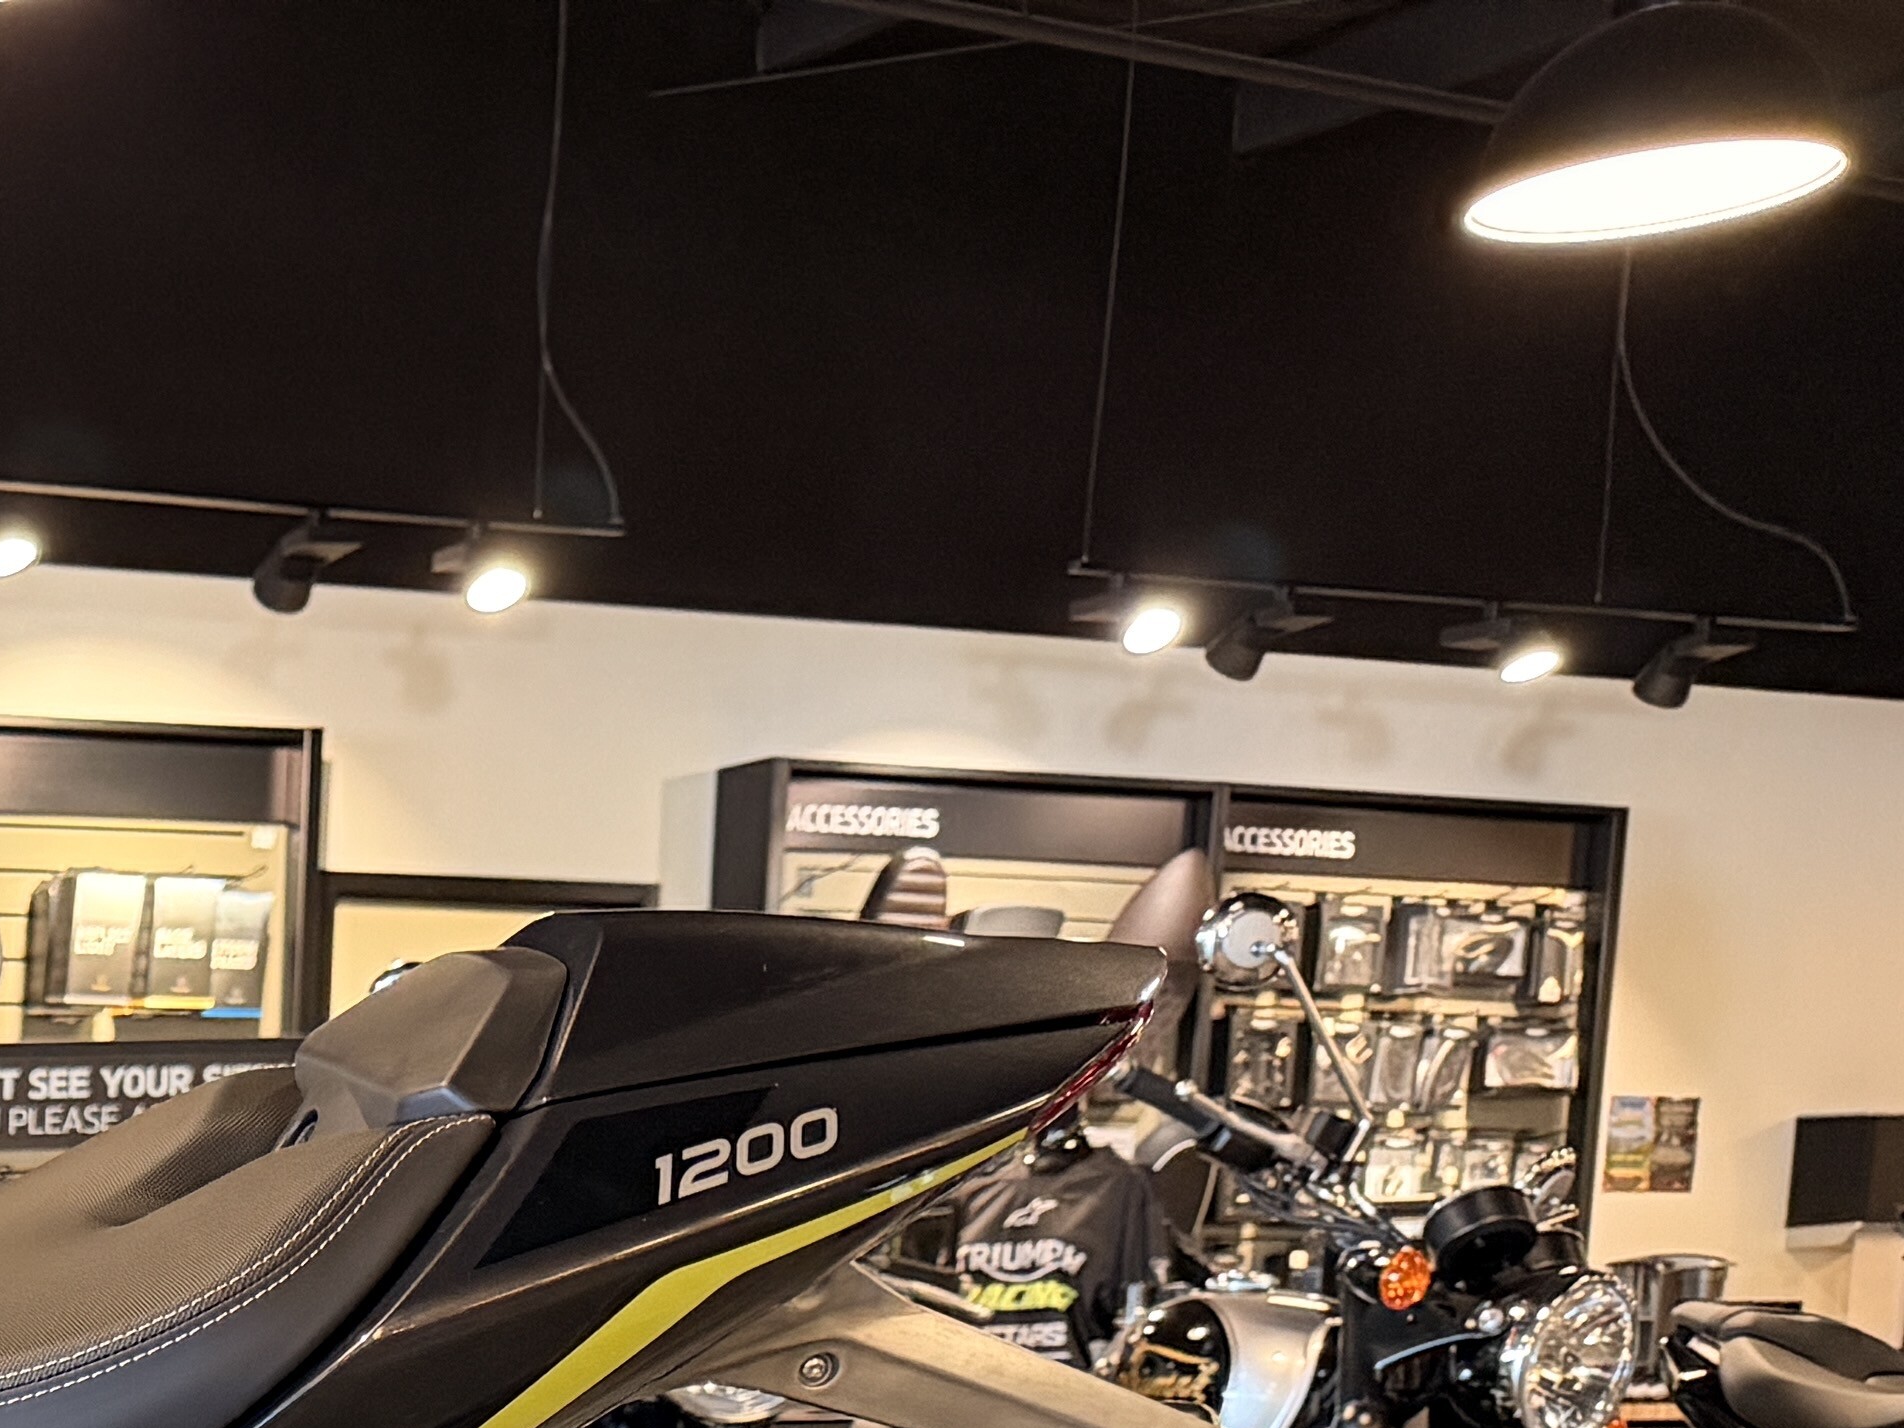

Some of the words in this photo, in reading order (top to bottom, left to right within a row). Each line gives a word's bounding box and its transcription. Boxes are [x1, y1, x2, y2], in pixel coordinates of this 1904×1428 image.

[785, 803, 940, 839] ACCESSORIES
[28, 1066, 93, 1100] SEE
[99, 1064, 193, 1098] YOUR
[7, 1102, 119, 1137] PLEASE
[655, 1107, 839, 1206] 1200
[955, 1239, 1088, 1283] TRIUMPH
